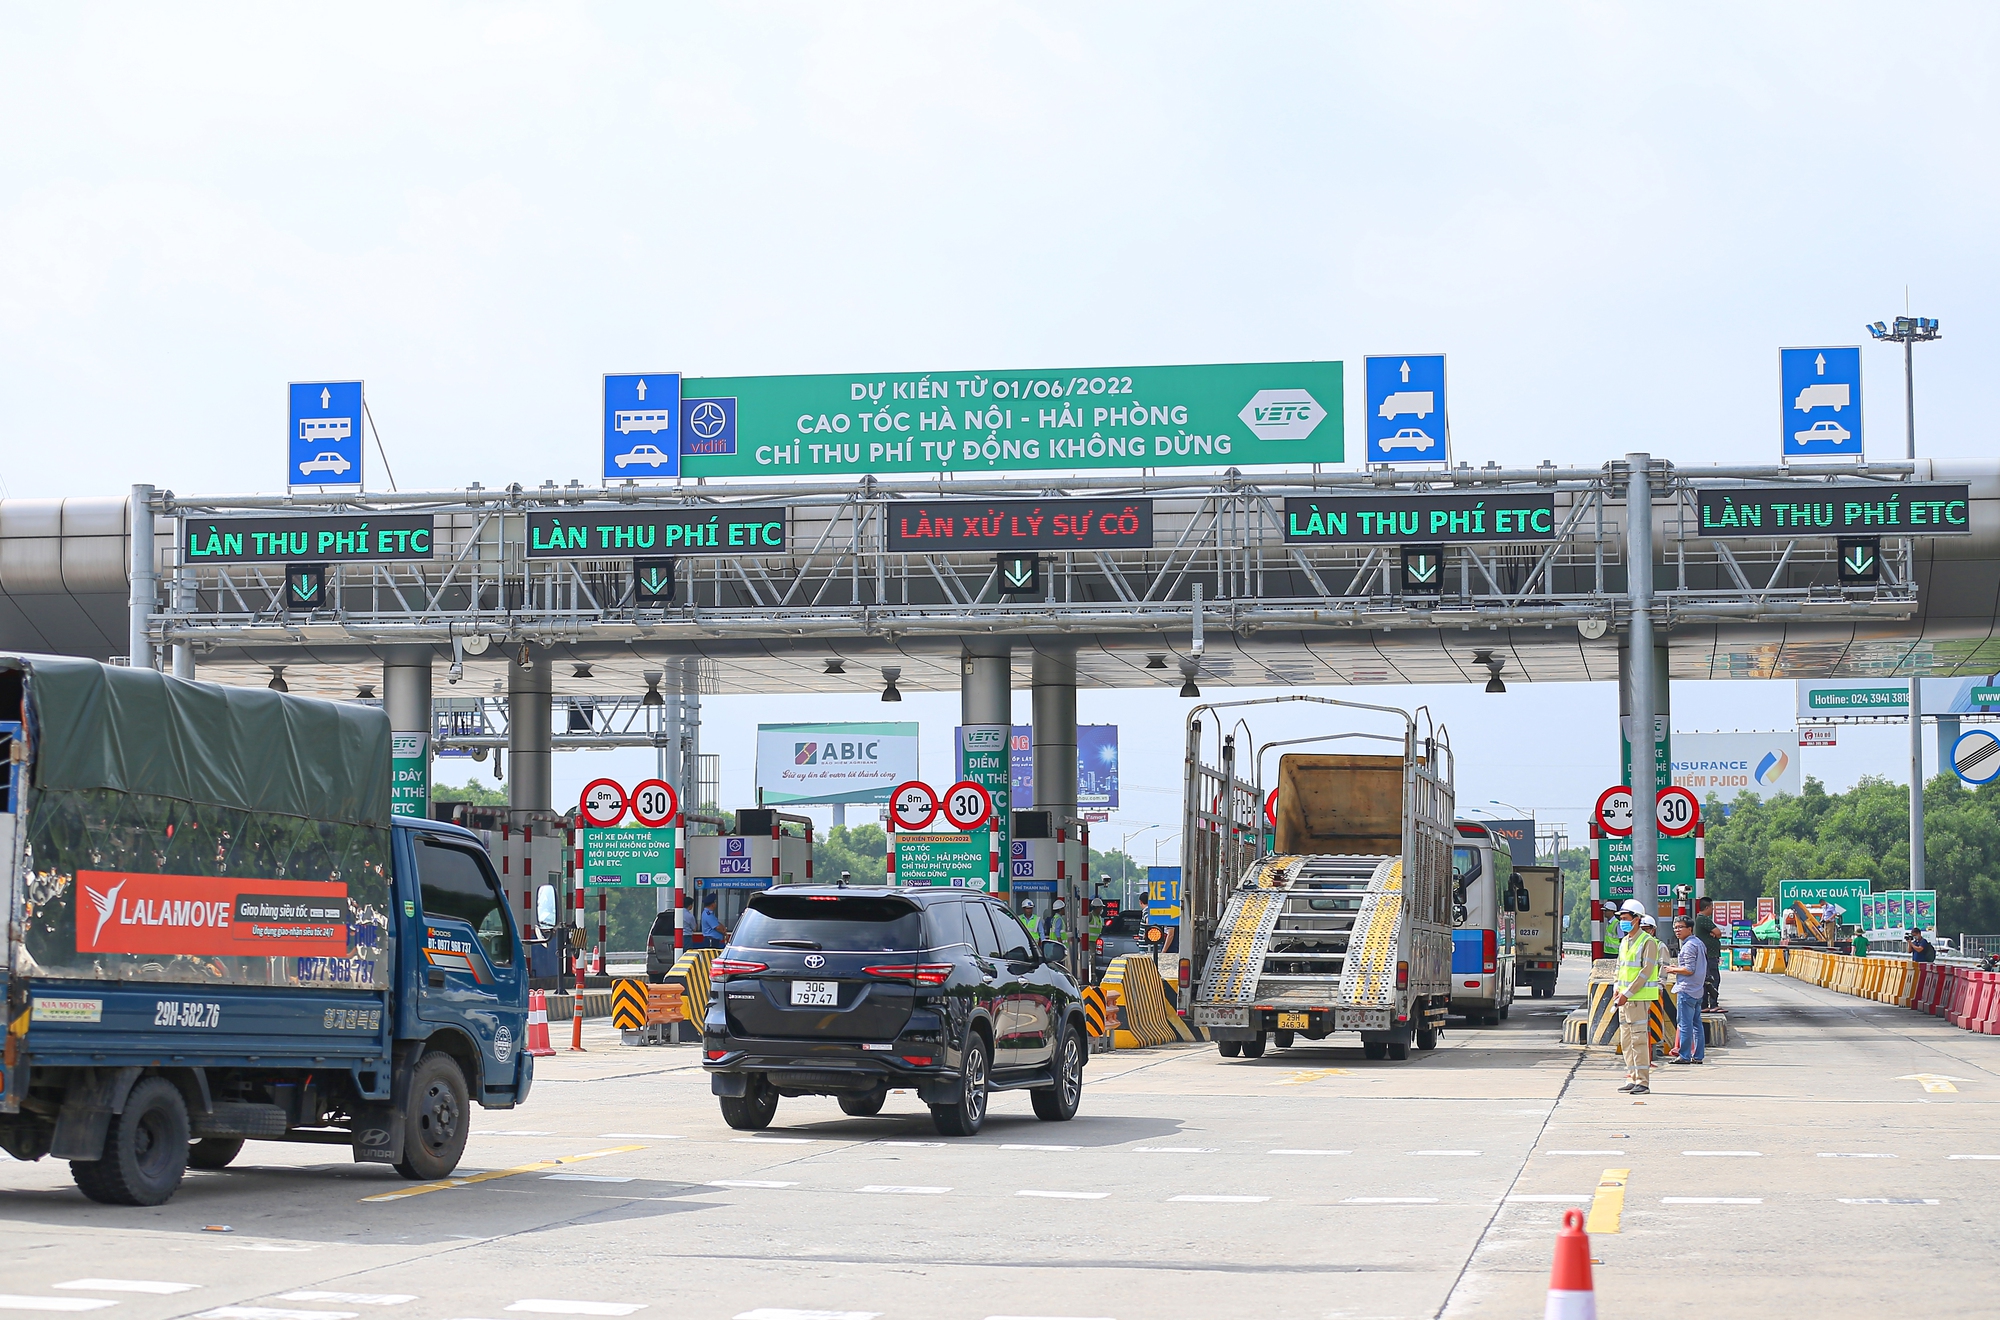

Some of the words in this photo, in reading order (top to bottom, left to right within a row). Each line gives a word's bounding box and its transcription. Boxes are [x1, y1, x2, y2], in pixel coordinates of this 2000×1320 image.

[852, 380, 886, 405] DỰ
[894, 375, 948, 400] KIẾN
[956, 376, 988, 398] TỪ
[992, 376, 1133, 400] 01/06/2022
[797, 414, 850, 434] CAO
[858, 404, 910, 432] TỐC
[920, 405, 956, 431] HÀ
[965, 404, 1012, 435] NỘI
[1040, 402, 1082, 428] HẢI
[1094, 401, 1188, 427] PHÒNG
[1254, 405, 1312, 422] VETC
[690, 439, 727, 454] vidifi
[755, 438, 800, 464] CHỈ
[808, 443, 860, 464] THU
[870, 436, 914, 462] PHÍ
[921, 439, 956, 466] TỰ
[963, 434, 1040, 466] ĐỘNG
[1050, 432, 1145, 458] KHÔNG
[1155, 430, 1232, 456] DỪNG
[1703, 496, 1762, 528] LÀN
[1770, 503, 1834, 527] THU
[1844, 493, 1901, 525] PHÍ
[1910, 500, 1966, 524] ETC
[901, 510, 954, 538] LÀN
[962, 508, 1004, 538] XỬ
[1012, 508, 1044, 536] LÝ
[1052, 510, 1094, 540] SỰ
[1100, 506, 1139, 535] CỐ
[1290, 504, 1348, 536] LÀN
[1356, 511, 1419, 535] THU
[1430, 502, 1486, 534] PHÍ
[1495, 508, 1550, 532] ETC
[190, 526, 243, 556] LÀN
[250, 532, 308, 555] THU
[318, 522, 368, 554] PHÍ
[378, 529, 429, 552] ETC
[532, 518, 588, 550] LÀN
[596, 525, 656, 548] THU
[666, 516, 718, 547] PHÍ
[728, 522, 782, 546] ETC
[1814, 694, 1849, 704] Hotline:
[1852, 694, 1868, 704] 024
[1870, 693, 1890, 704] 3941
[1978, 693, 2000, 702] www
[969, 733, 1000, 741] VETC
[822, 742, 878, 760] ABIC
[969, 753, 999, 768] ĐIỂM
[1671, 761, 1748, 771] NSURANCE
[399, 768, 422, 781] ĐÂY
[987, 770, 1007, 784] THẺ
[1674, 772, 1706, 787] HIỂM
[1710, 776, 1748, 786] PJICO
[403, 784, 425, 797] THẺ
[597, 792, 612, 800] 8m
[643, 792, 666, 814] 30
[907, 794, 922, 803] 8m
[1614, 800, 1628, 808] 8m
[956, 795, 978, 816] 30
[1663, 799, 1687, 822] 30
[589, 832, 603, 840] CHỈ
[636, 832, 652, 840] THẺ
[1609, 842, 1631, 852] ĐIỂM
[902, 852, 914, 861] HÀ
[915, 852, 929, 862] NỘI
[937, 852, 950, 860] HẢI
[952, 852, 982, 861] PHÒNG
[1609, 853, 1628, 861] DÁN
[732, 859, 750, 872] 04
[1014, 863, 1033, 876] 03
[1609, 873, 1633, 883] CÁCH
[1149, 881, 1165, 900] XE
[1784, 886, 1798, 898] LỐI
[1801, 890, 1813, 898] RA
[1816, 889, 1827, 897] XE
[1829, 886, 1849, 897] QUÁ
[120, 898, 231, 927] LALAMOVE
[241, 903, 259, 917] Giao
[260, 903, 278, 920] hàng
[280, 904, 294, 917] siêu
[296, 904, 308, 917] tốc
[252, 925, 263, 938] Ứng
[323, 928, 334, 936] 24/7
[462, 942, 471, 953] 737
[299, 957, 326, 982] 0977
[330, 958, 350, 982] 968
[353, 959, 375, 984] 737
[805, 982, 825, 992] 30G
[797, 993, 833, 1004] 797.47
[59, 1002, 96, 1010] MOTORS
[154, 1001, 220, 1028] 29H-582.76
